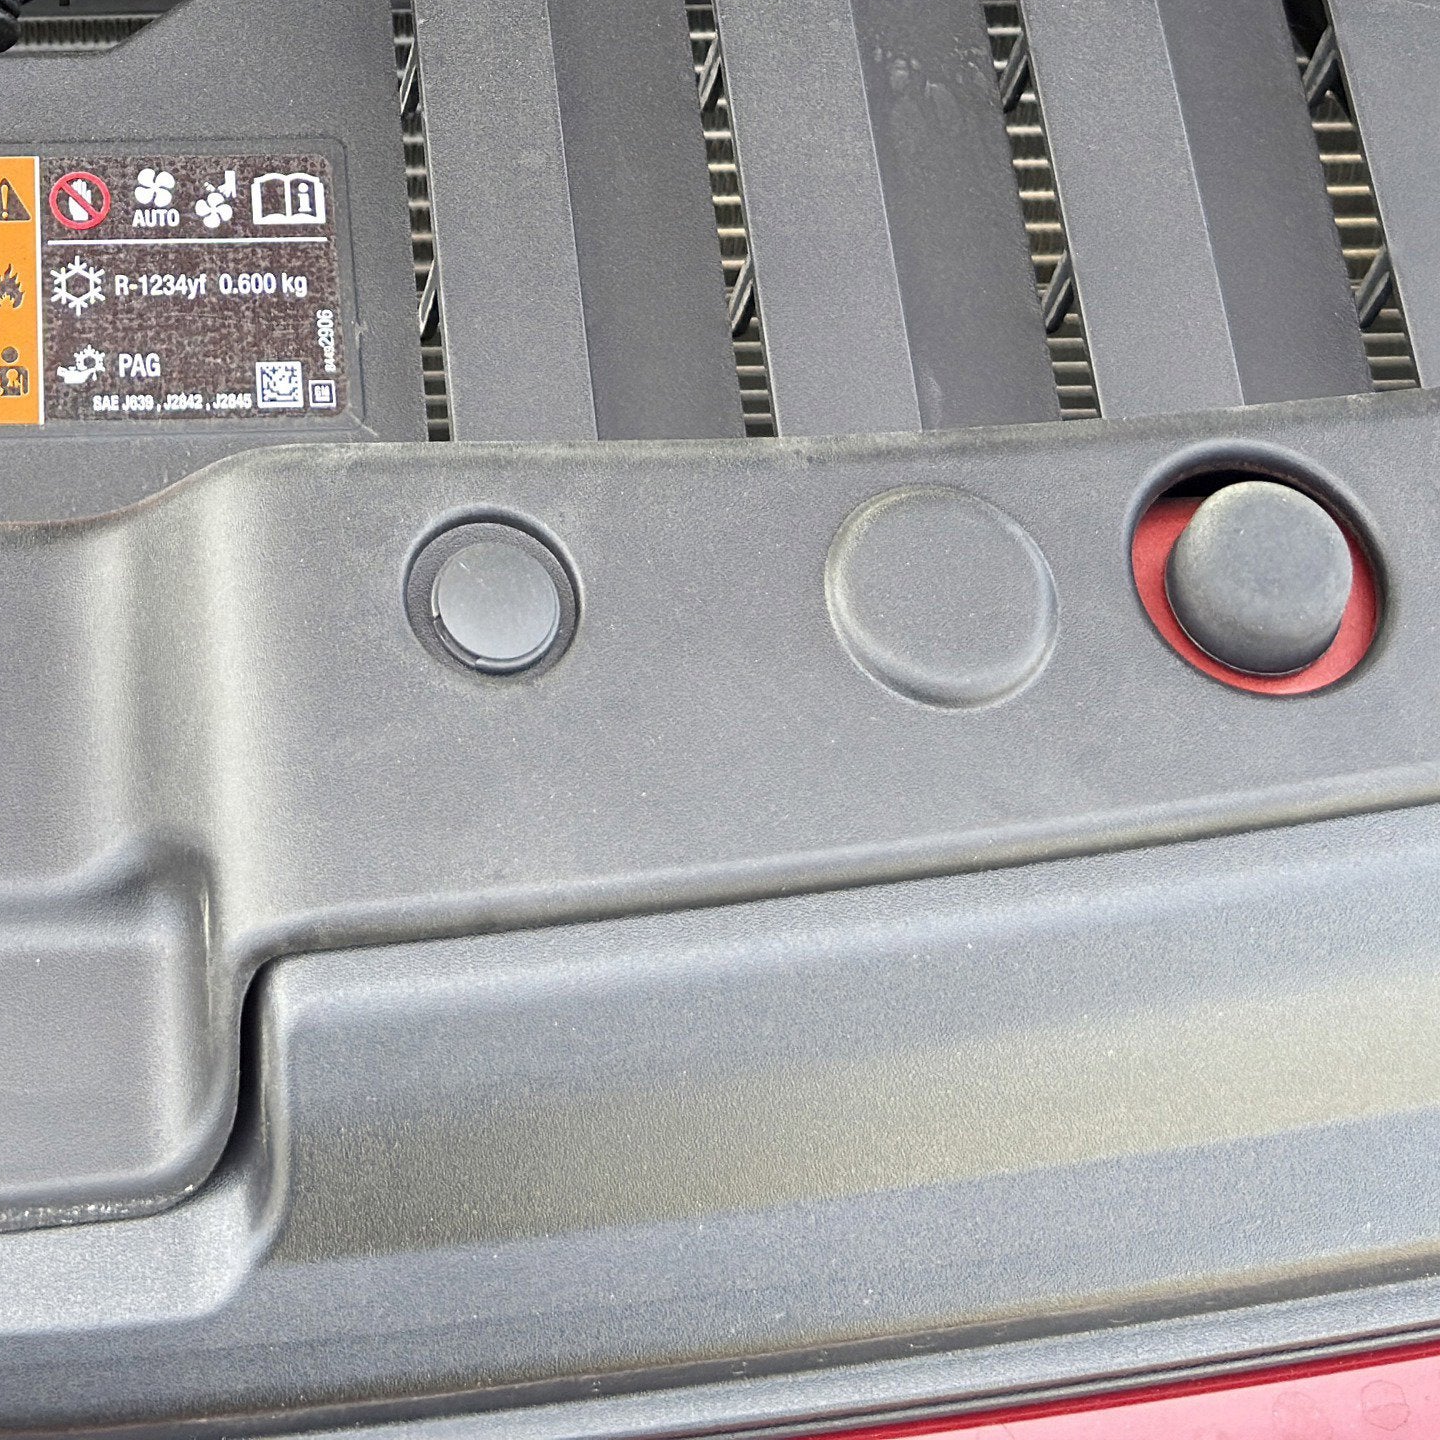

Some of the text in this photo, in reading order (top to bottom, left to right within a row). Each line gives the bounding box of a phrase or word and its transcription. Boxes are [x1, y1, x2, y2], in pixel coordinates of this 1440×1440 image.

[132, 208, 180, 228] AUTO
[115, 272, 308, 298] R-1234yf 0.600 kg
[118, 352, 161, 379] PAG
[93, 394, 120, 411] SAE
